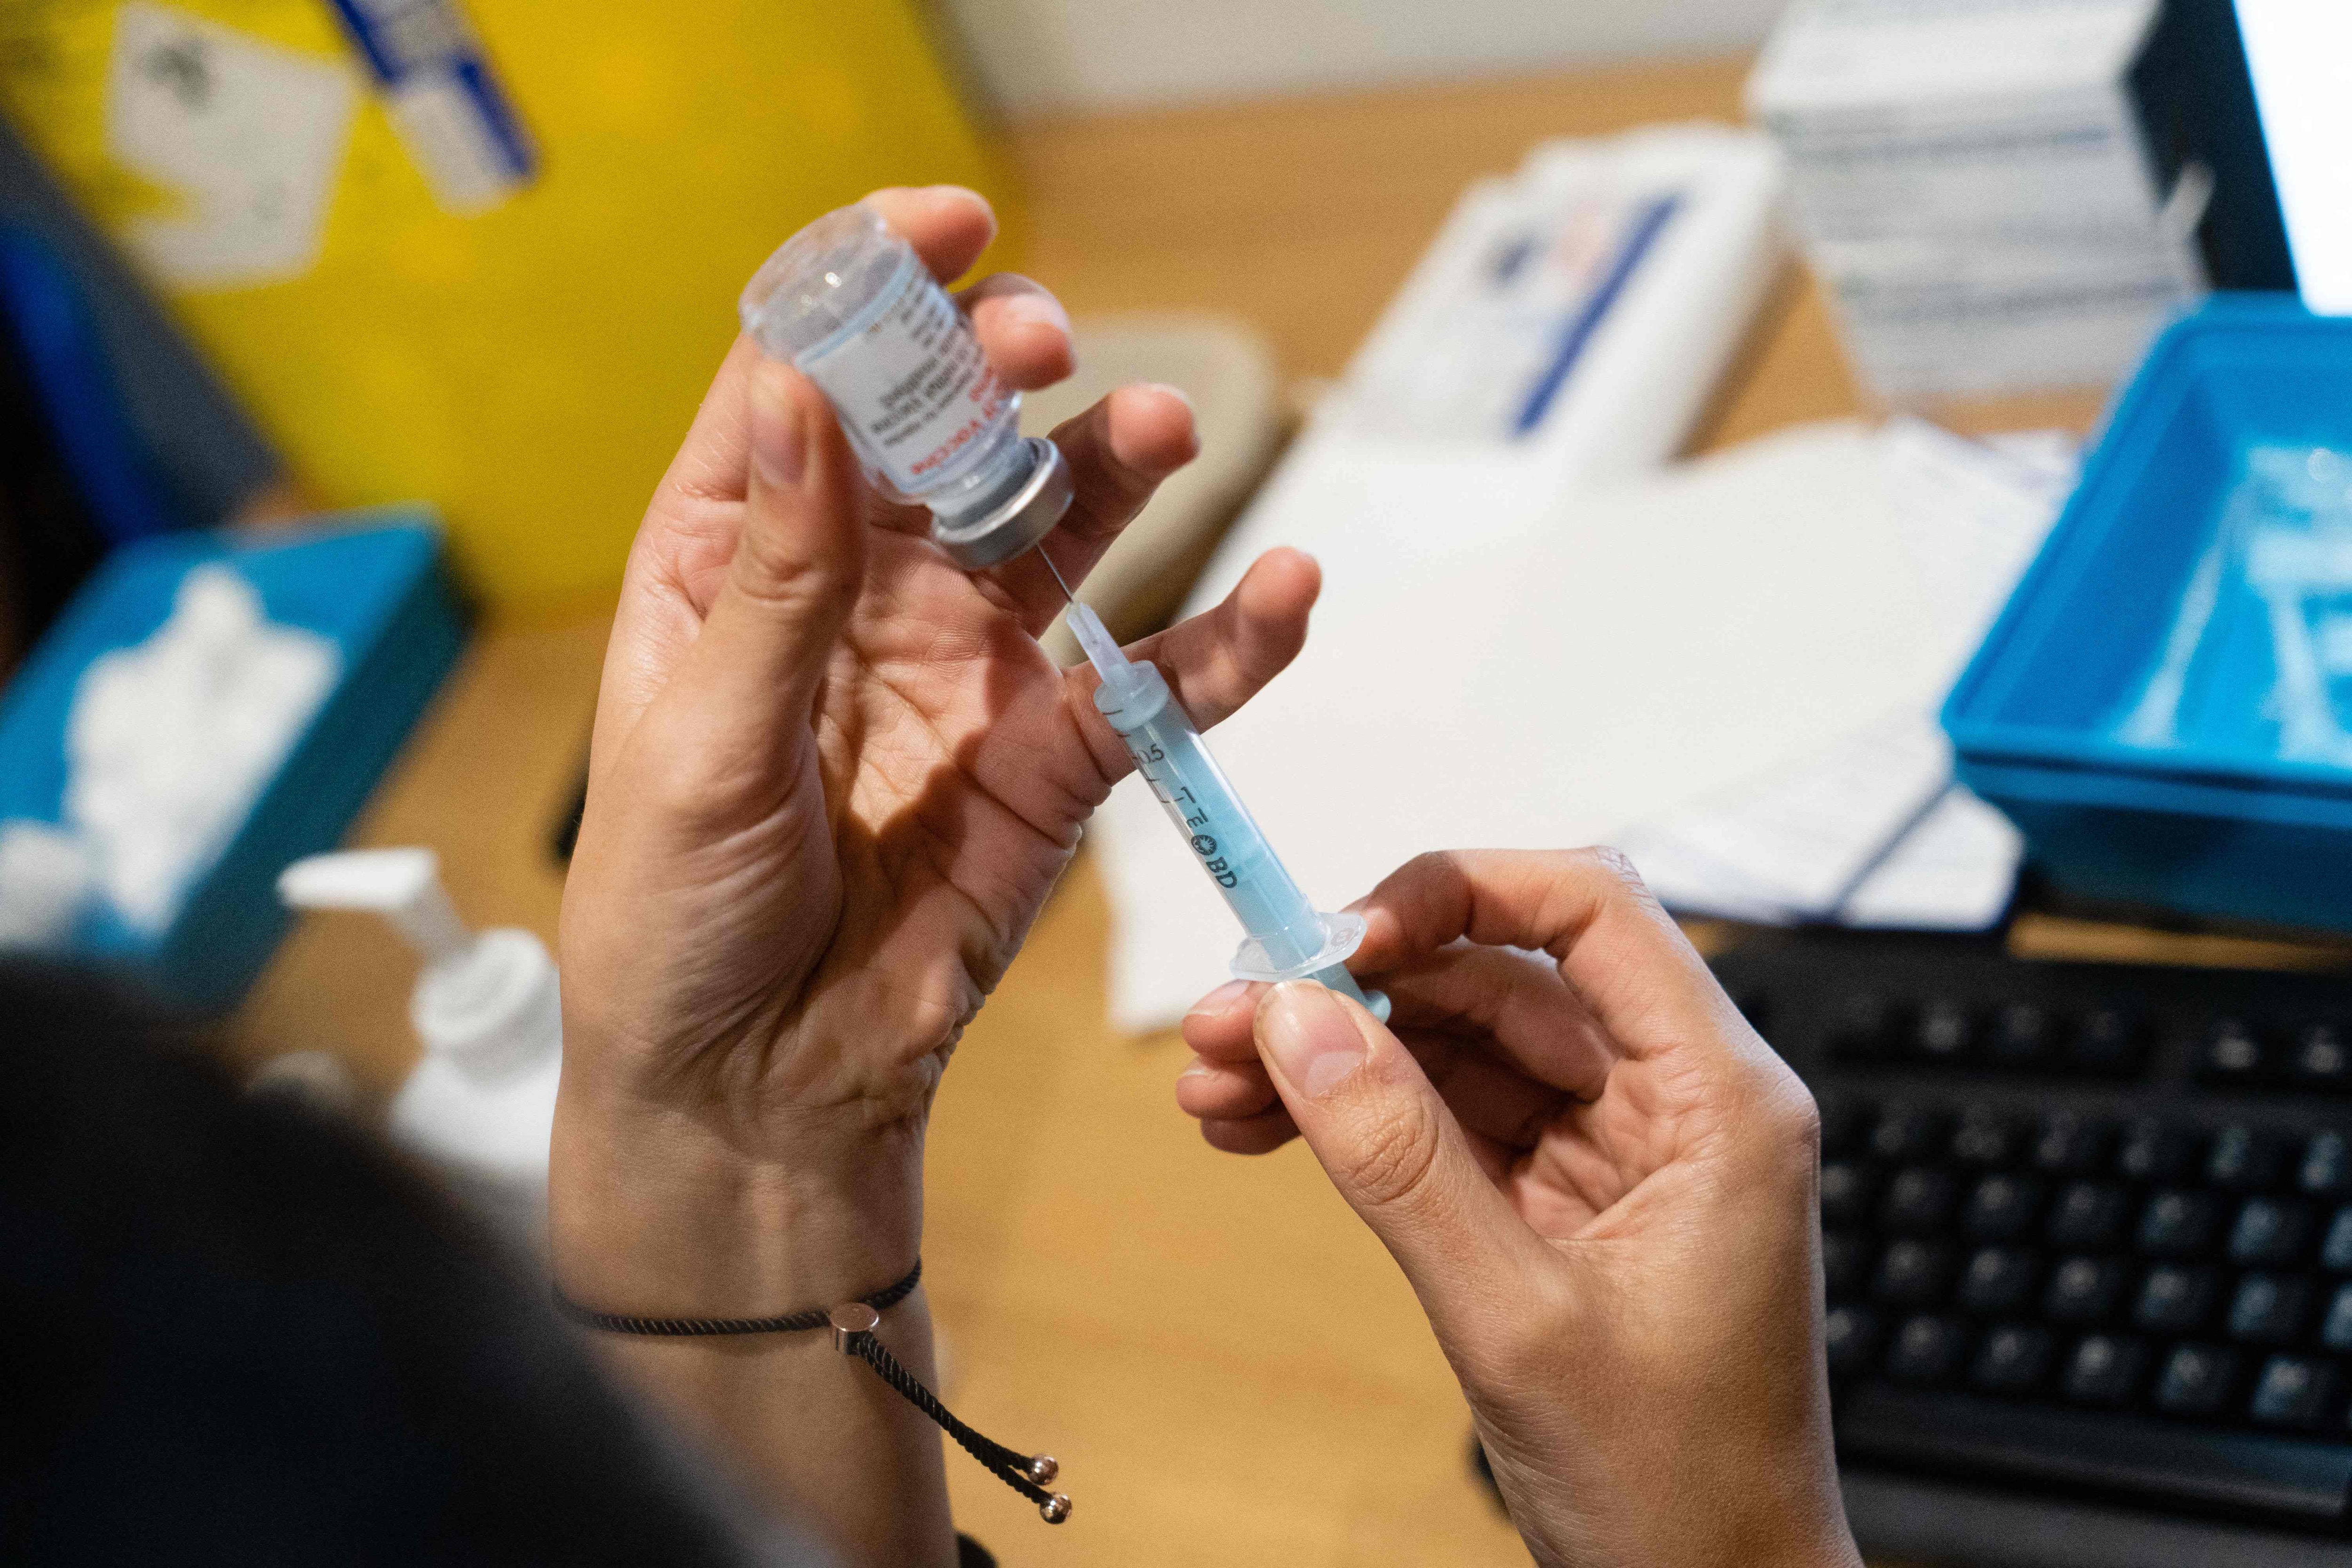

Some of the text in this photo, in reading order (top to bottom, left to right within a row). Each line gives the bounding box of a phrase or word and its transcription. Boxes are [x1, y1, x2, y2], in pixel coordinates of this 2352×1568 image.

[910, 419, 983, 474] Vaccine
[1180, 786, 1196, 803] 1
[1206, 856, 1238, 888] BD
